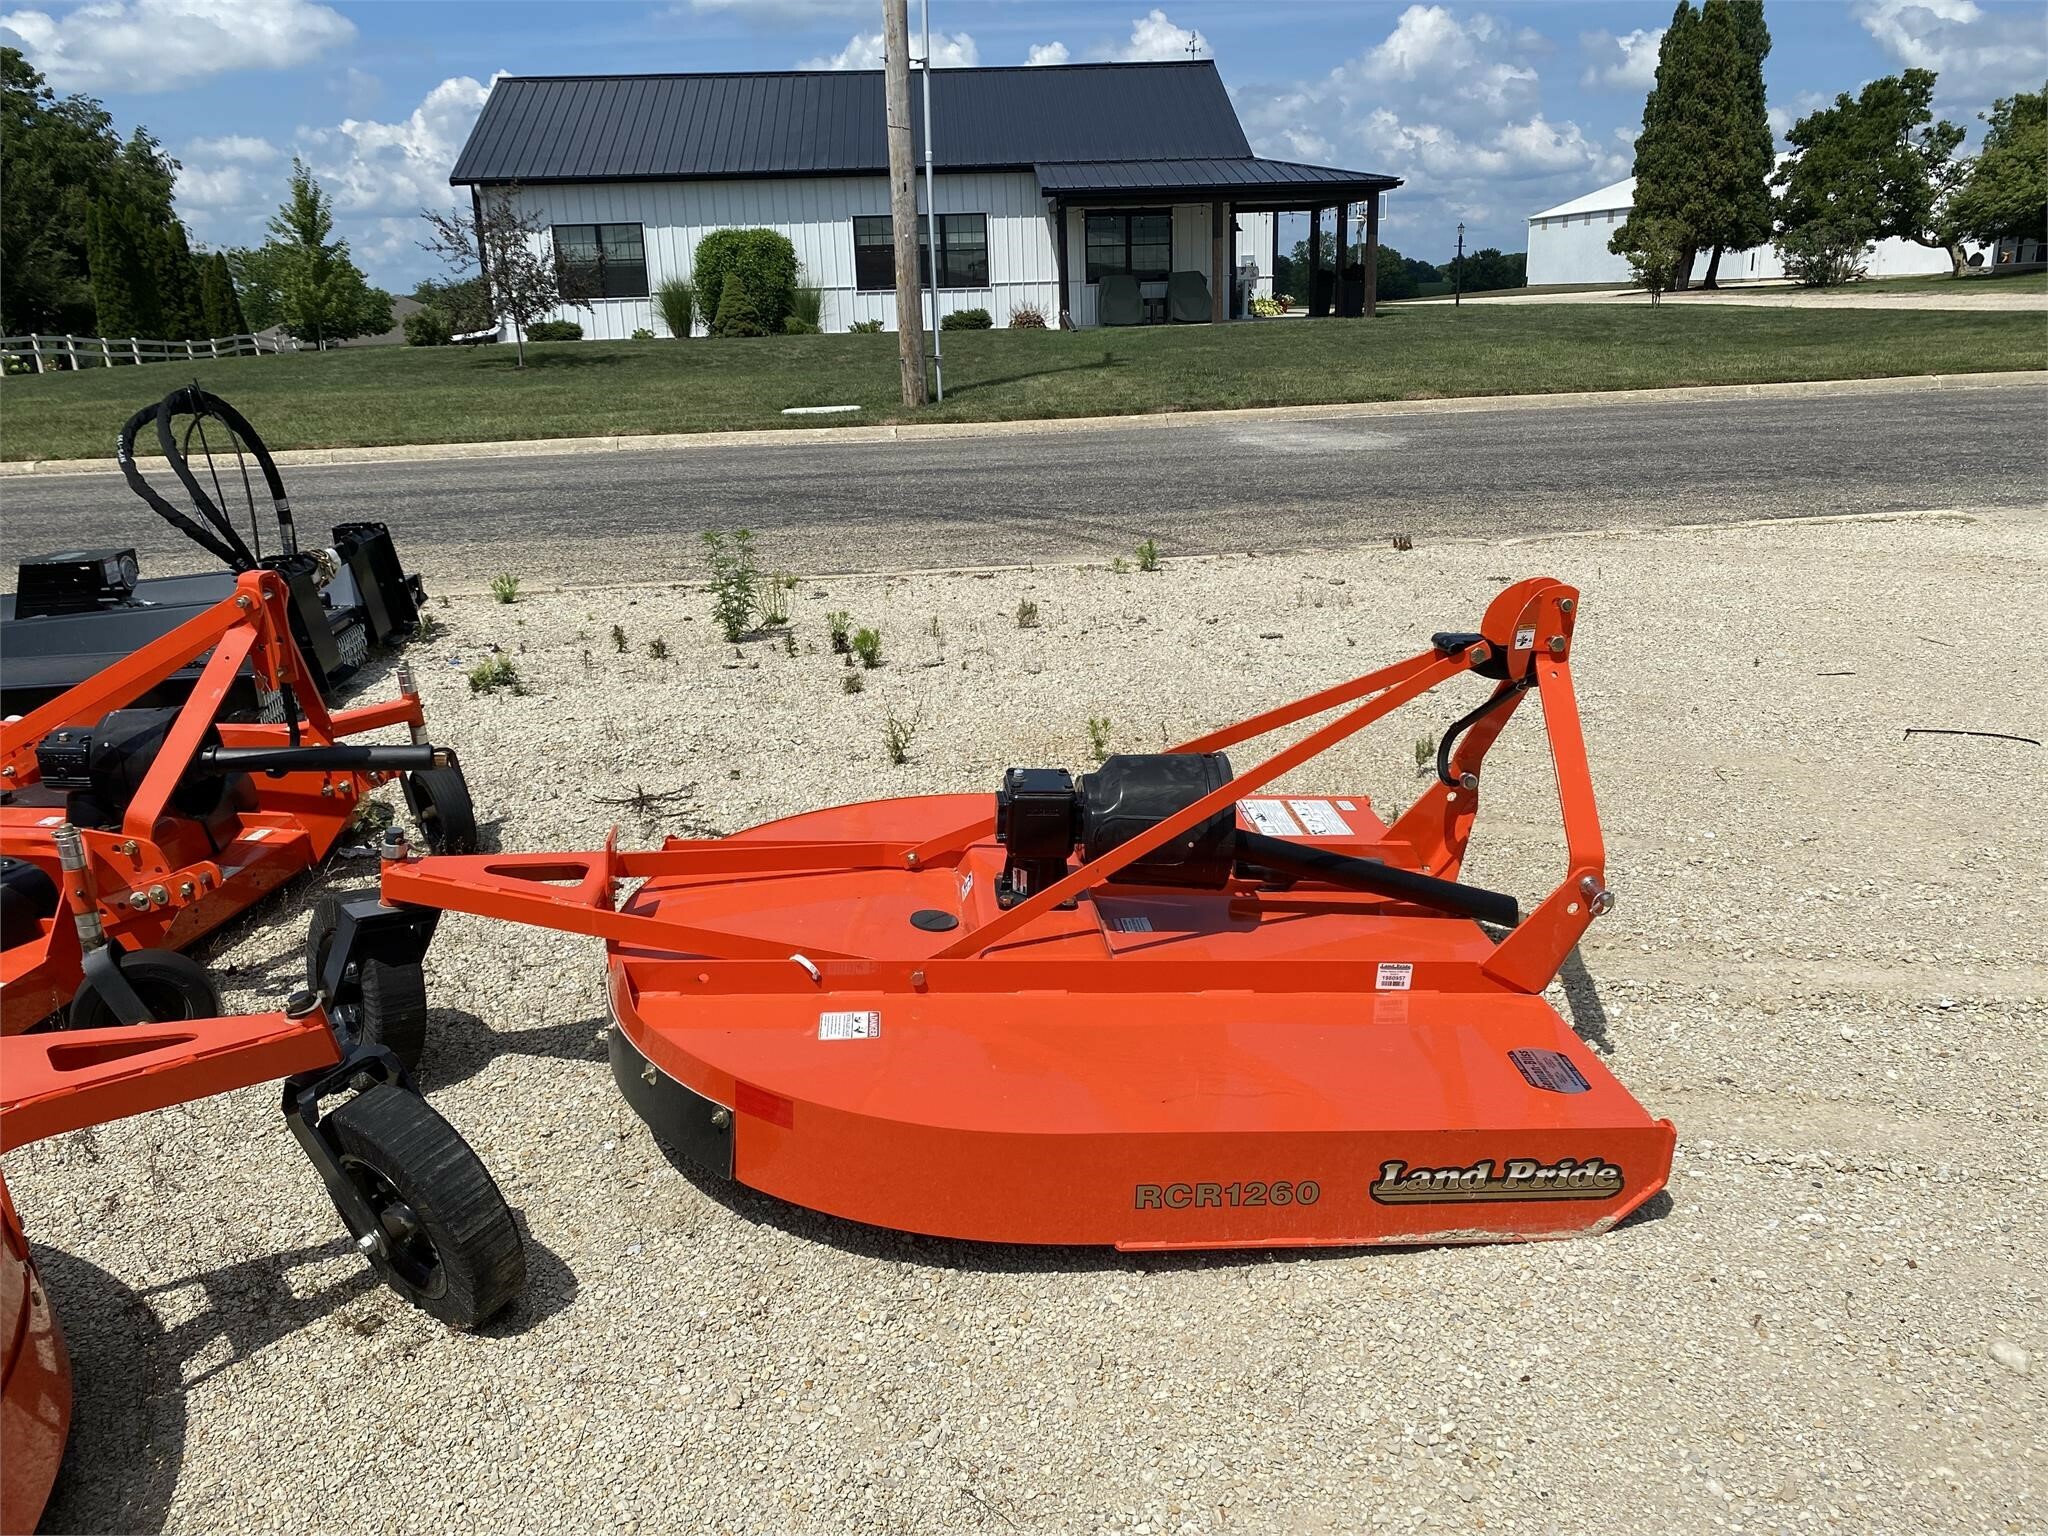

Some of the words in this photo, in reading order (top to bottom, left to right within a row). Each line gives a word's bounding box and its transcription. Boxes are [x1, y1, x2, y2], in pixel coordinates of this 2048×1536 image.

[1377, 1160, 1493, 1193] Land
[1502, 1160, 1620, 1190] Pride
[1135, 1180, 1320, 1209] RCR1260
